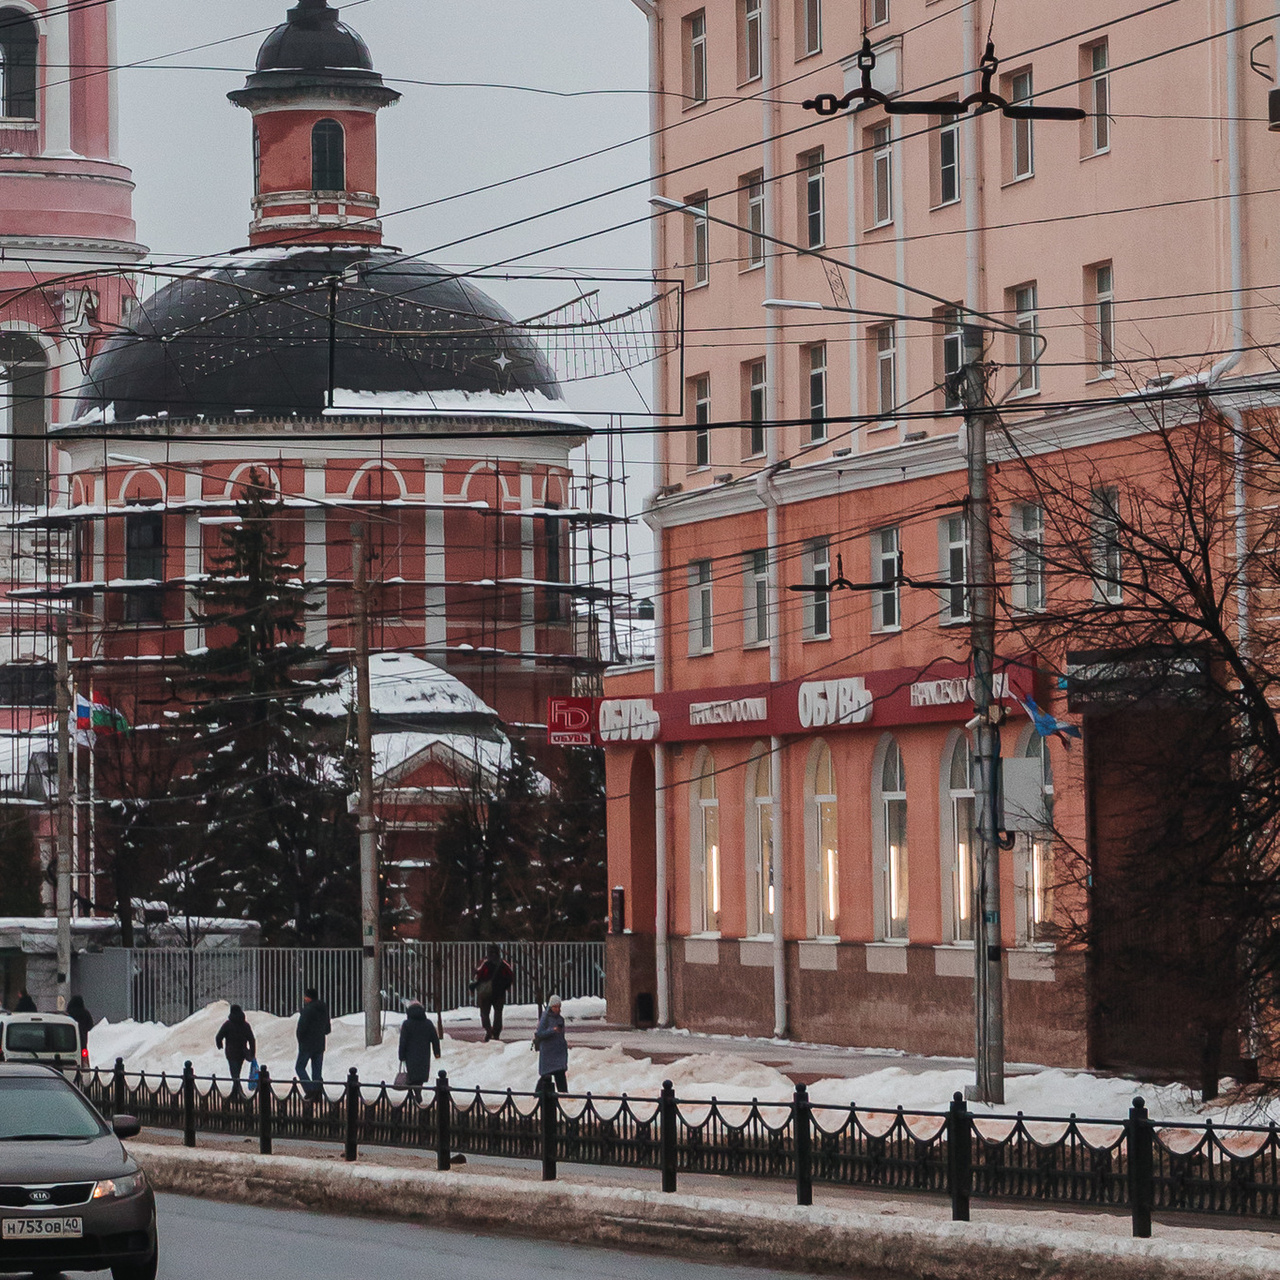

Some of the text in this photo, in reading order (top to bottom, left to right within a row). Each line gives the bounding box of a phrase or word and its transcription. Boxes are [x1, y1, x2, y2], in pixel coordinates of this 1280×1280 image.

[798, 677, 874, 729] ОБУВЬ
[599, 699, 660, 742] ОБУВЬ
[553, 734, 588, 743] ОБУВЬ
[7, 1218, 79, 1234] Н753ОВ 40
